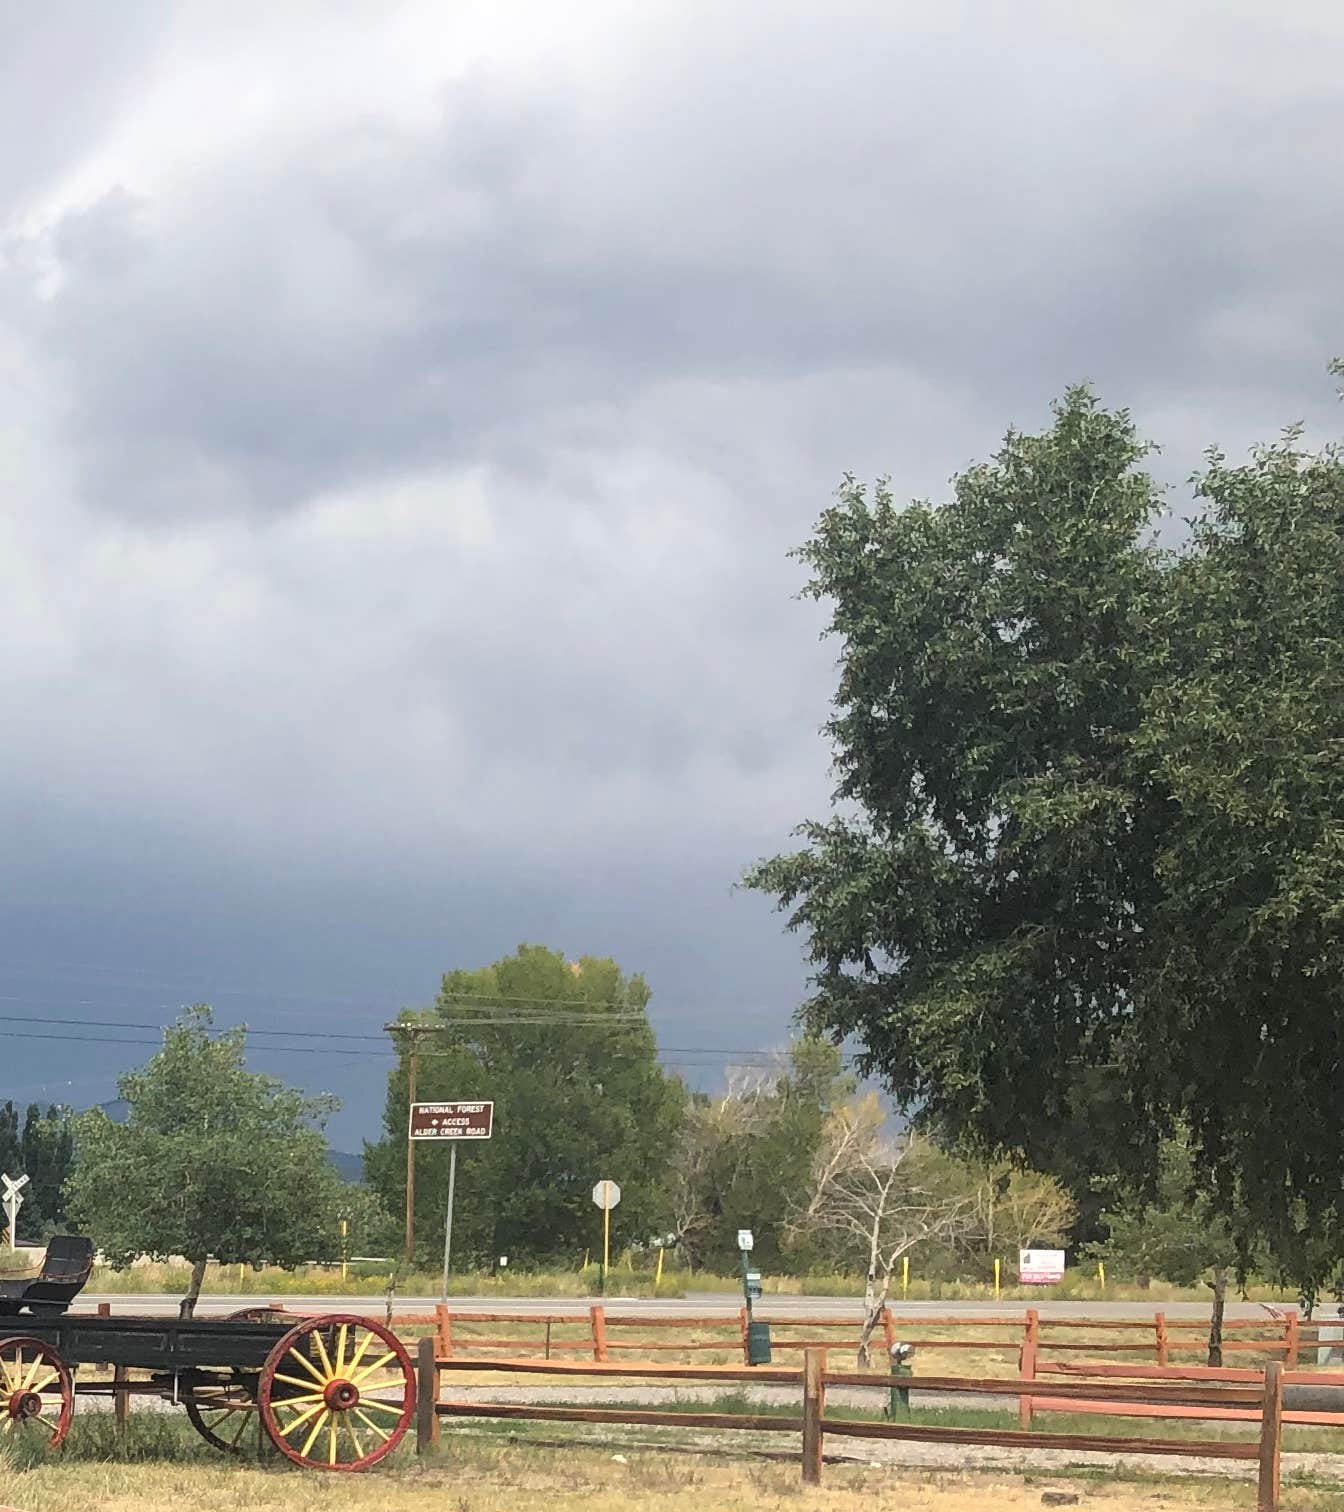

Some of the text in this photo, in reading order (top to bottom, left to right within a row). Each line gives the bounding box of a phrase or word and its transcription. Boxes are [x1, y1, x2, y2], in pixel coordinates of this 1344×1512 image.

[419, 1105, 485, 1114] NATIONAL FOREST
[442, 1118, 470, 1126] ACCESS
[414, 1128, 437, 1136] ALDER
[466, 1127, 486, 1135] ROAD
